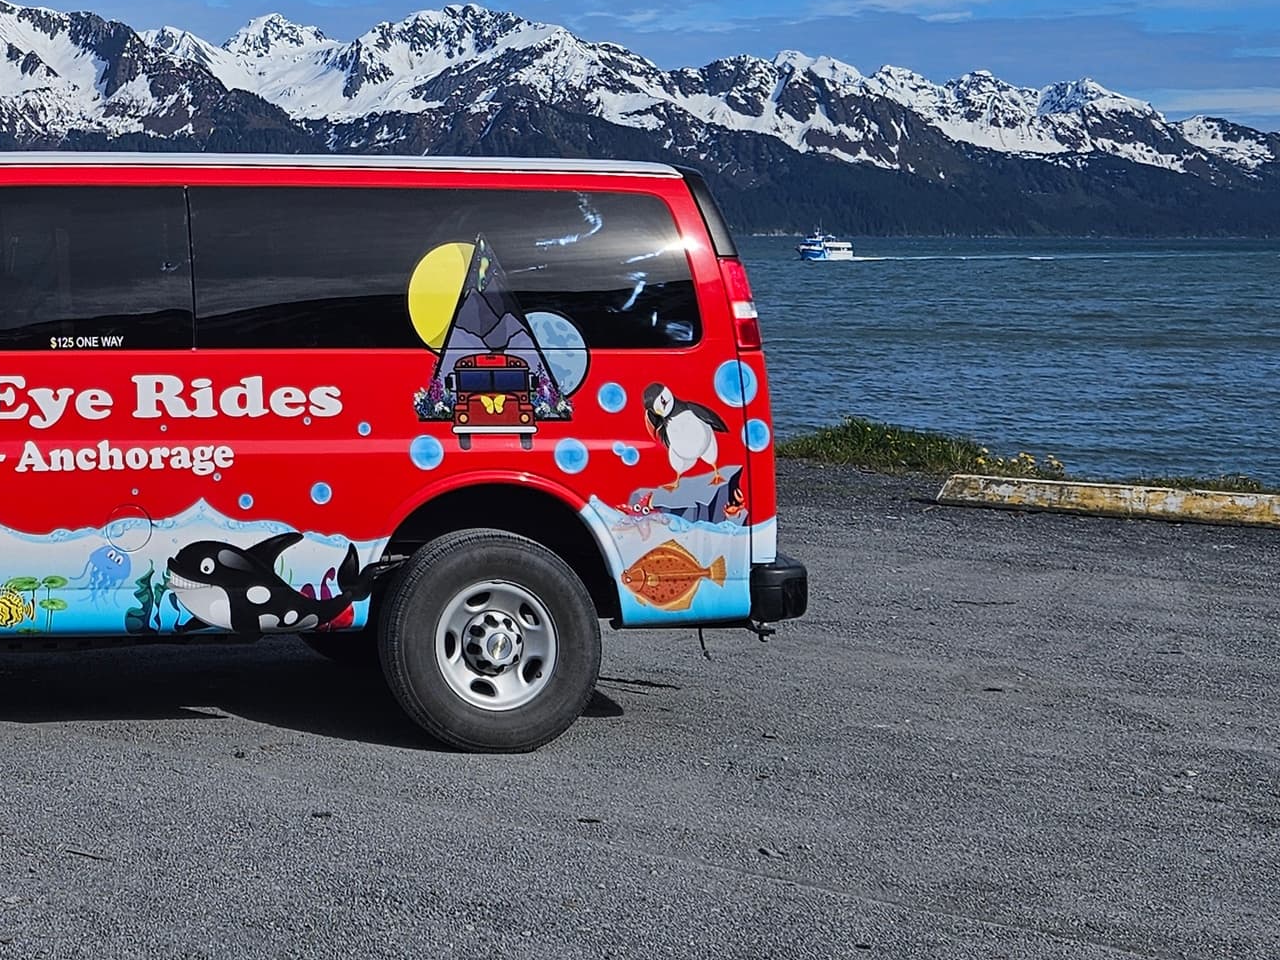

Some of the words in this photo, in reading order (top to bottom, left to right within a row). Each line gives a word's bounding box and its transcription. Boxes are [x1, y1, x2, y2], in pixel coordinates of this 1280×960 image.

[50, 336, 74, 349] $125
[76, 336, 99, 348] ONE
[100, 335, 124, 347] WAY
[131, 374, 343, 418] Rides
[14, 439, 235, 476] Anchorage
